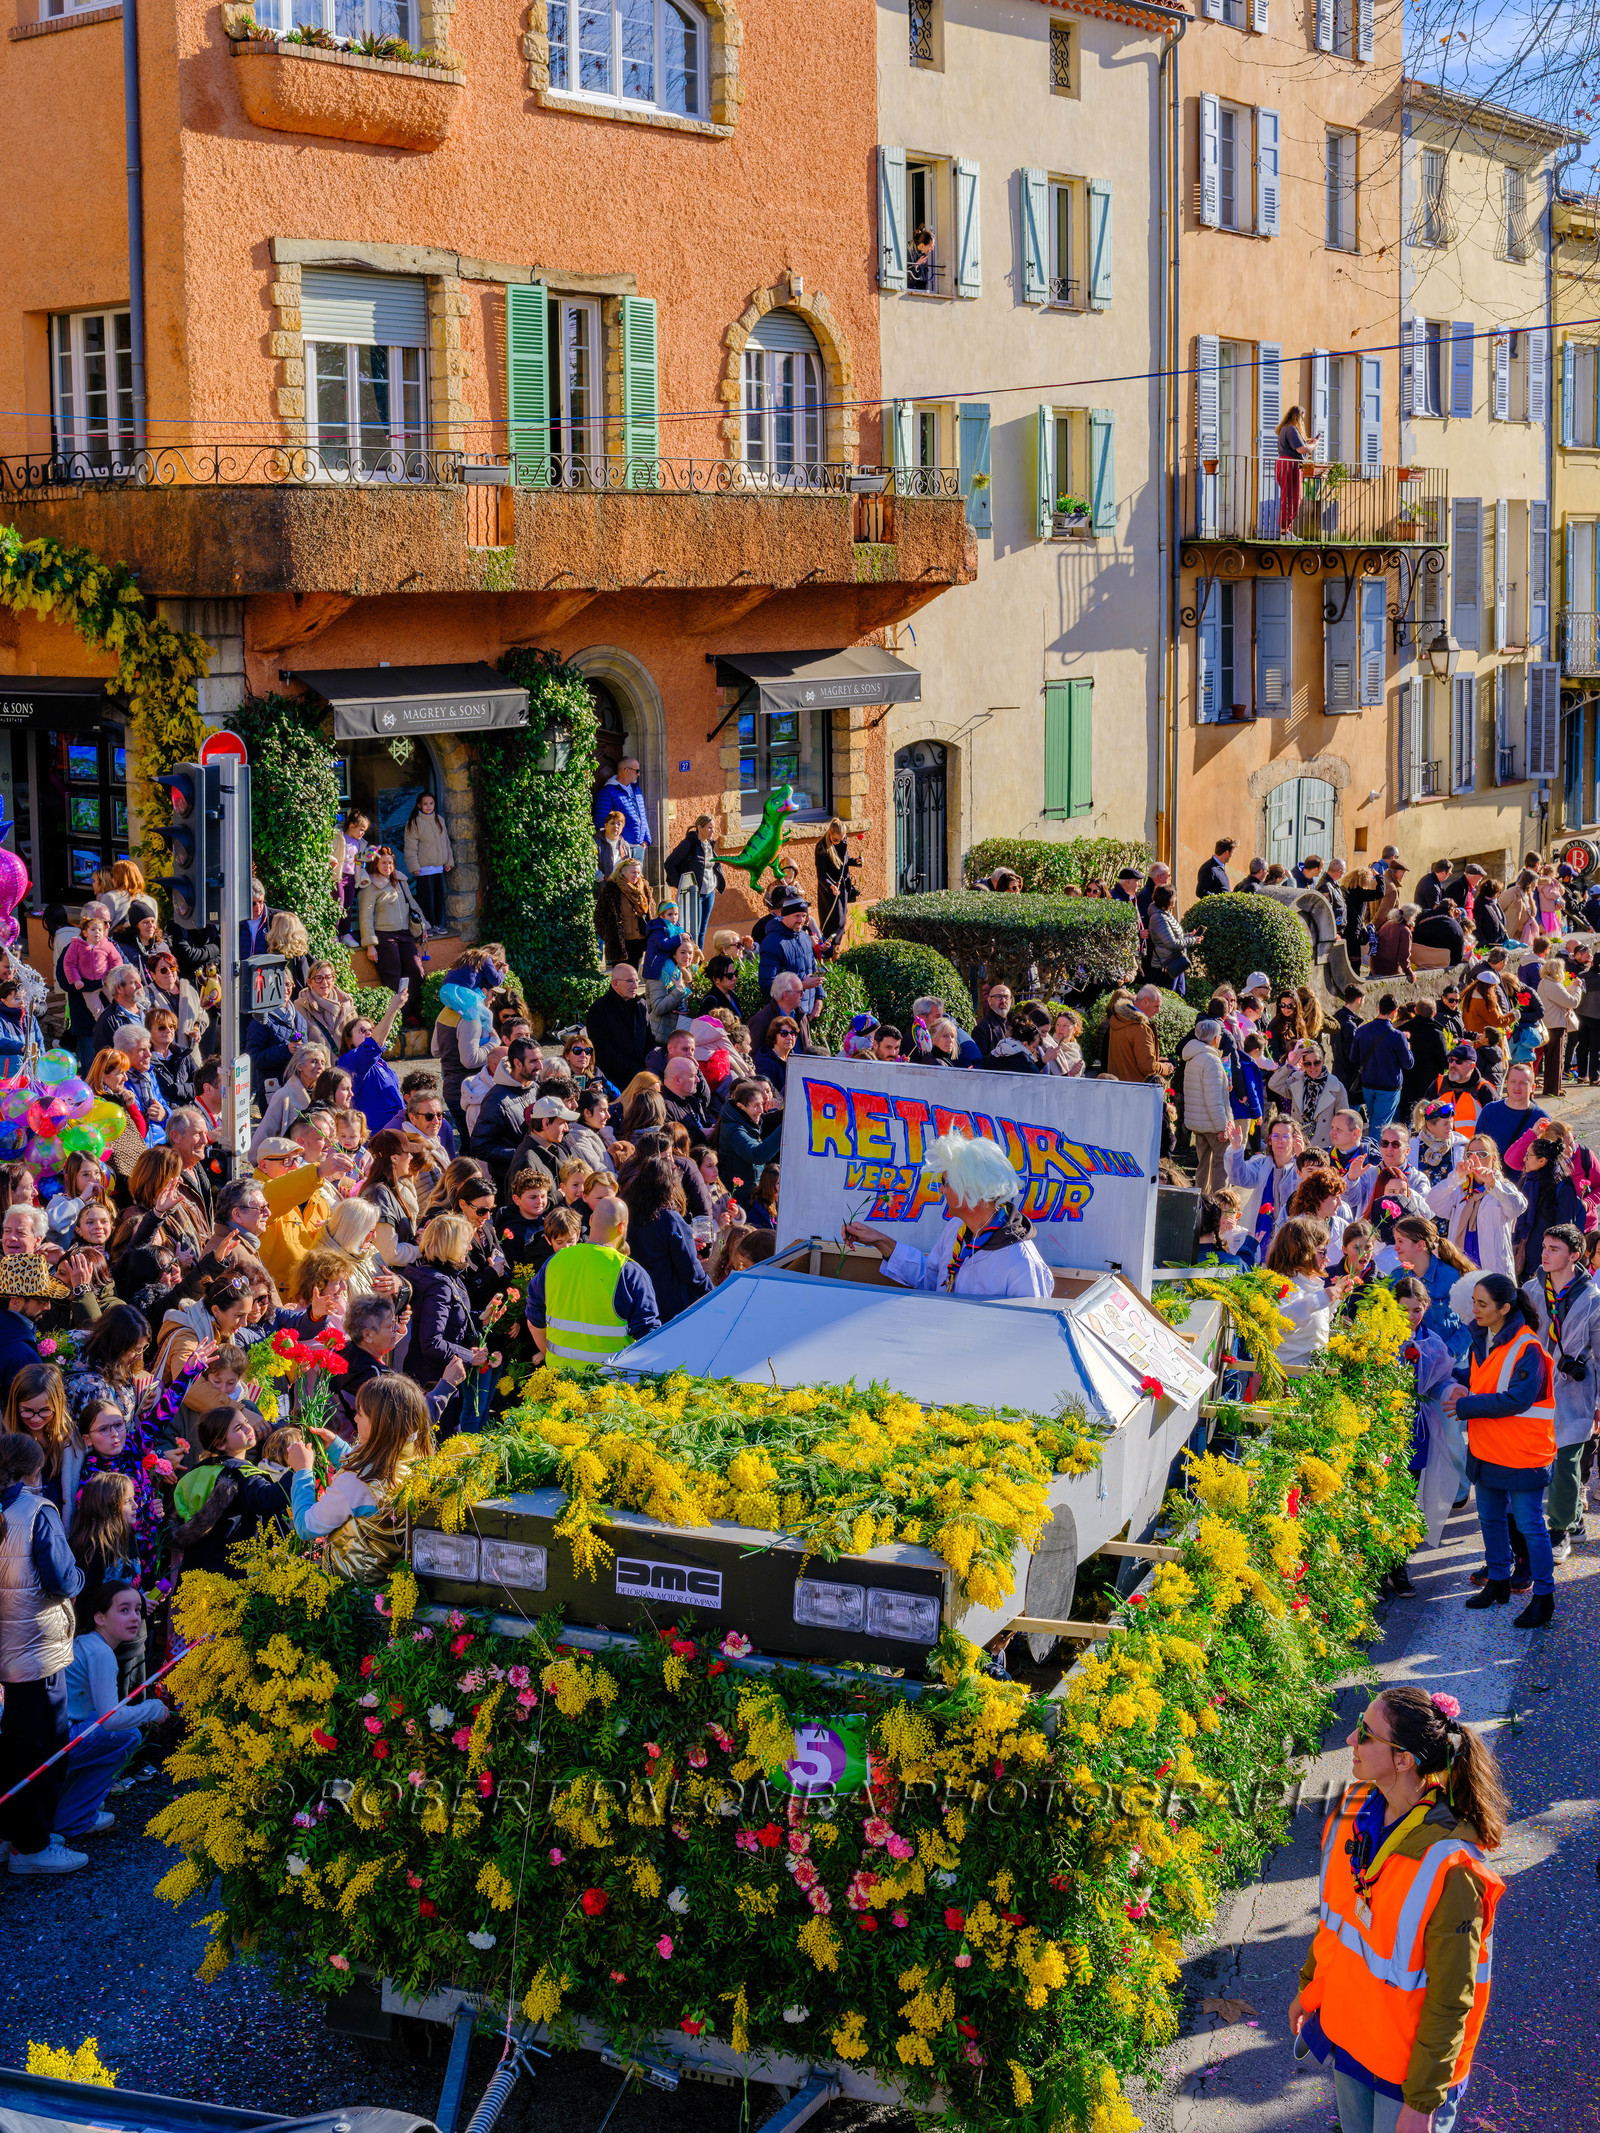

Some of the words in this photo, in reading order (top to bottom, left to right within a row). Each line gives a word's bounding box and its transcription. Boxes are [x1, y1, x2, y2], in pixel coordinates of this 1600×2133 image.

[820, 684, 852, 696] MAGREY
[853, 684, 860, 694] &
[861, 682, 881, 694] SONS
[3, 703, 10, 714] &
[11, 702, 34, 715] SONS
[403, 706, 447, 720] MAGREY
[449, 706, 457, 717] &
[460, 703, 486, 716] SONS
[681, 762, 689, 770] 27
[1566, 841, 1590, 851] BARNES
[1573, 850, 1584, 868] B
[843, 1161, 917, 1192] VERS
[901, 1167, 1094, 1222] FUR
[657, 1593, 684, 1603] MOTOR
[684, 1596, 720, 1608] COMPANY
[790, 1728, 832, 1788] 5
